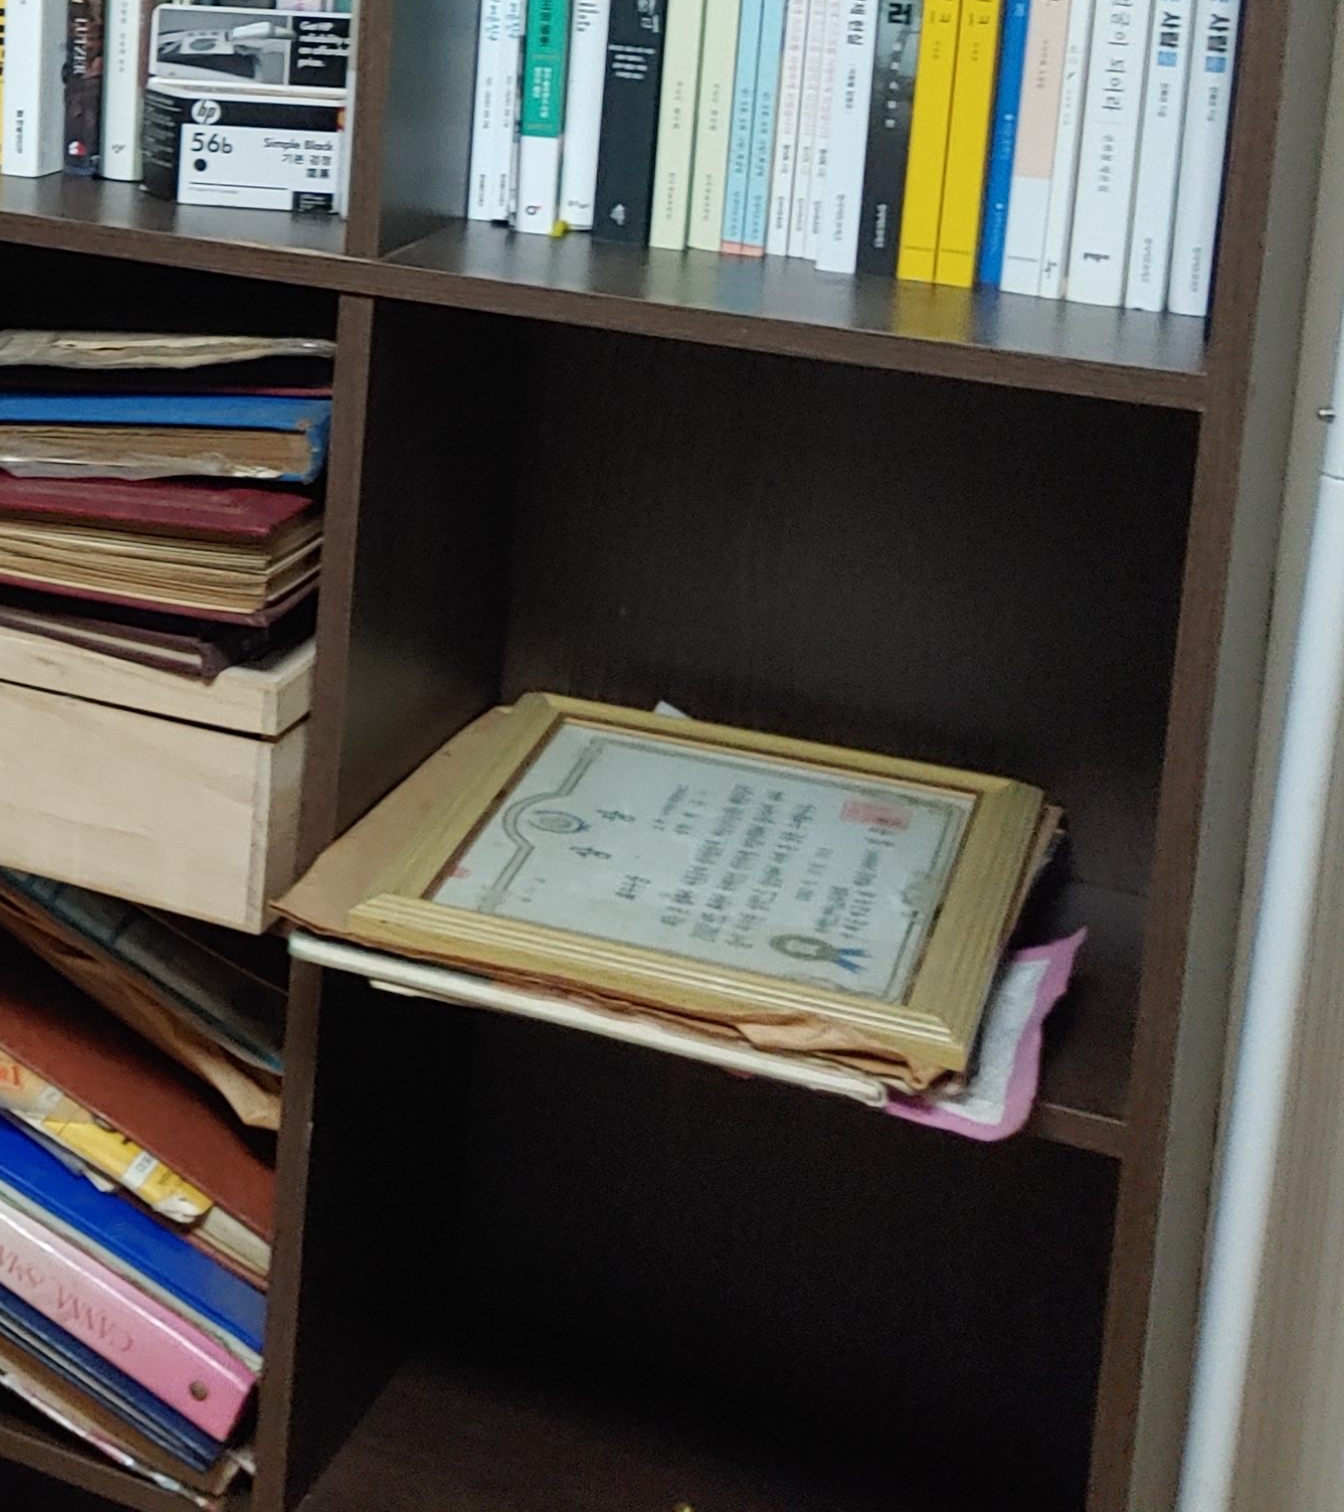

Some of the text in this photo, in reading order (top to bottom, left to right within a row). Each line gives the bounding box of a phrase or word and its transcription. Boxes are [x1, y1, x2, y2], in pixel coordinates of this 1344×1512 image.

[846, 18, 864, 46] 현실
[198, 98, 216, 125] hp
[190, 132, 233, 154] 56b
[263, 136, 300, 152] Simple
